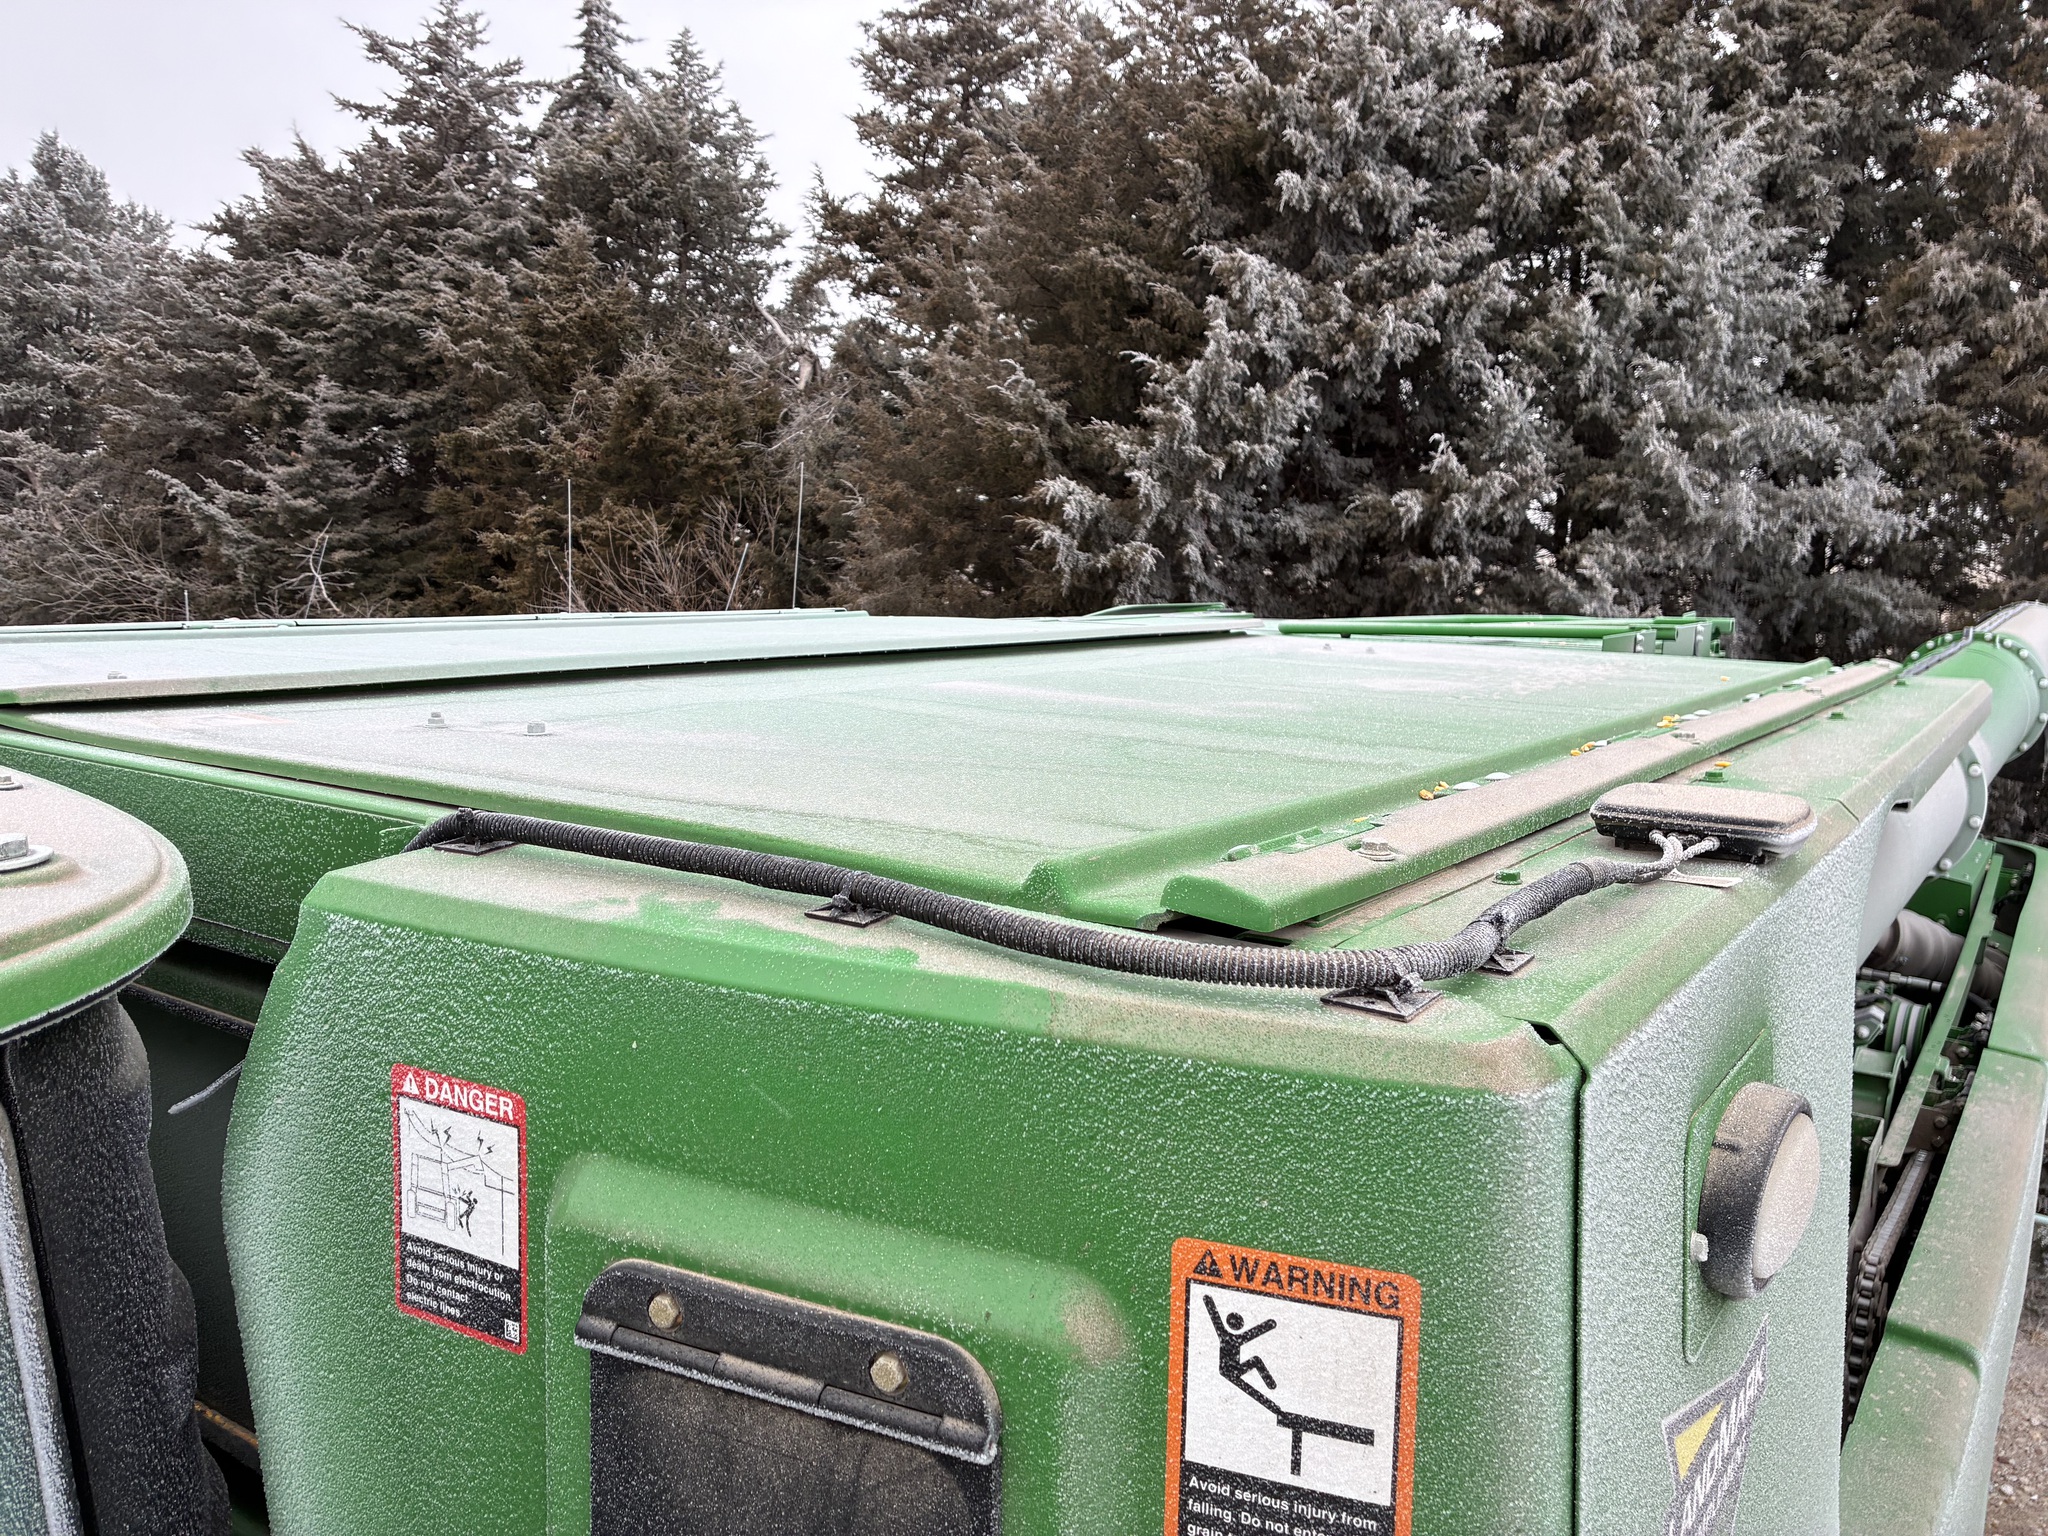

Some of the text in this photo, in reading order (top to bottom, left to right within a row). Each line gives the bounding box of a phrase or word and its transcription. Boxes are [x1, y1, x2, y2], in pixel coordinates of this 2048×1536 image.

[425, 1076, 513, 1120] DANGER
[406, 1241, 504, 1282] Avoid serious injury or
[406, 1259, 514, 1302] death from electrocution.
[1229, 1253, 1401, 1311] WARNING
[406, 1274, 469, 1303] Do not contact
[406, 1291, 438, 1308] electric
[1670, 1344, 1764, 1536] ANDMARK
[1189, 1476, 1377, 1531] Avoid serious injury from
[1241, 1511, 1261, 1527] Do
[1265, 1520, 1289, 1535] not
